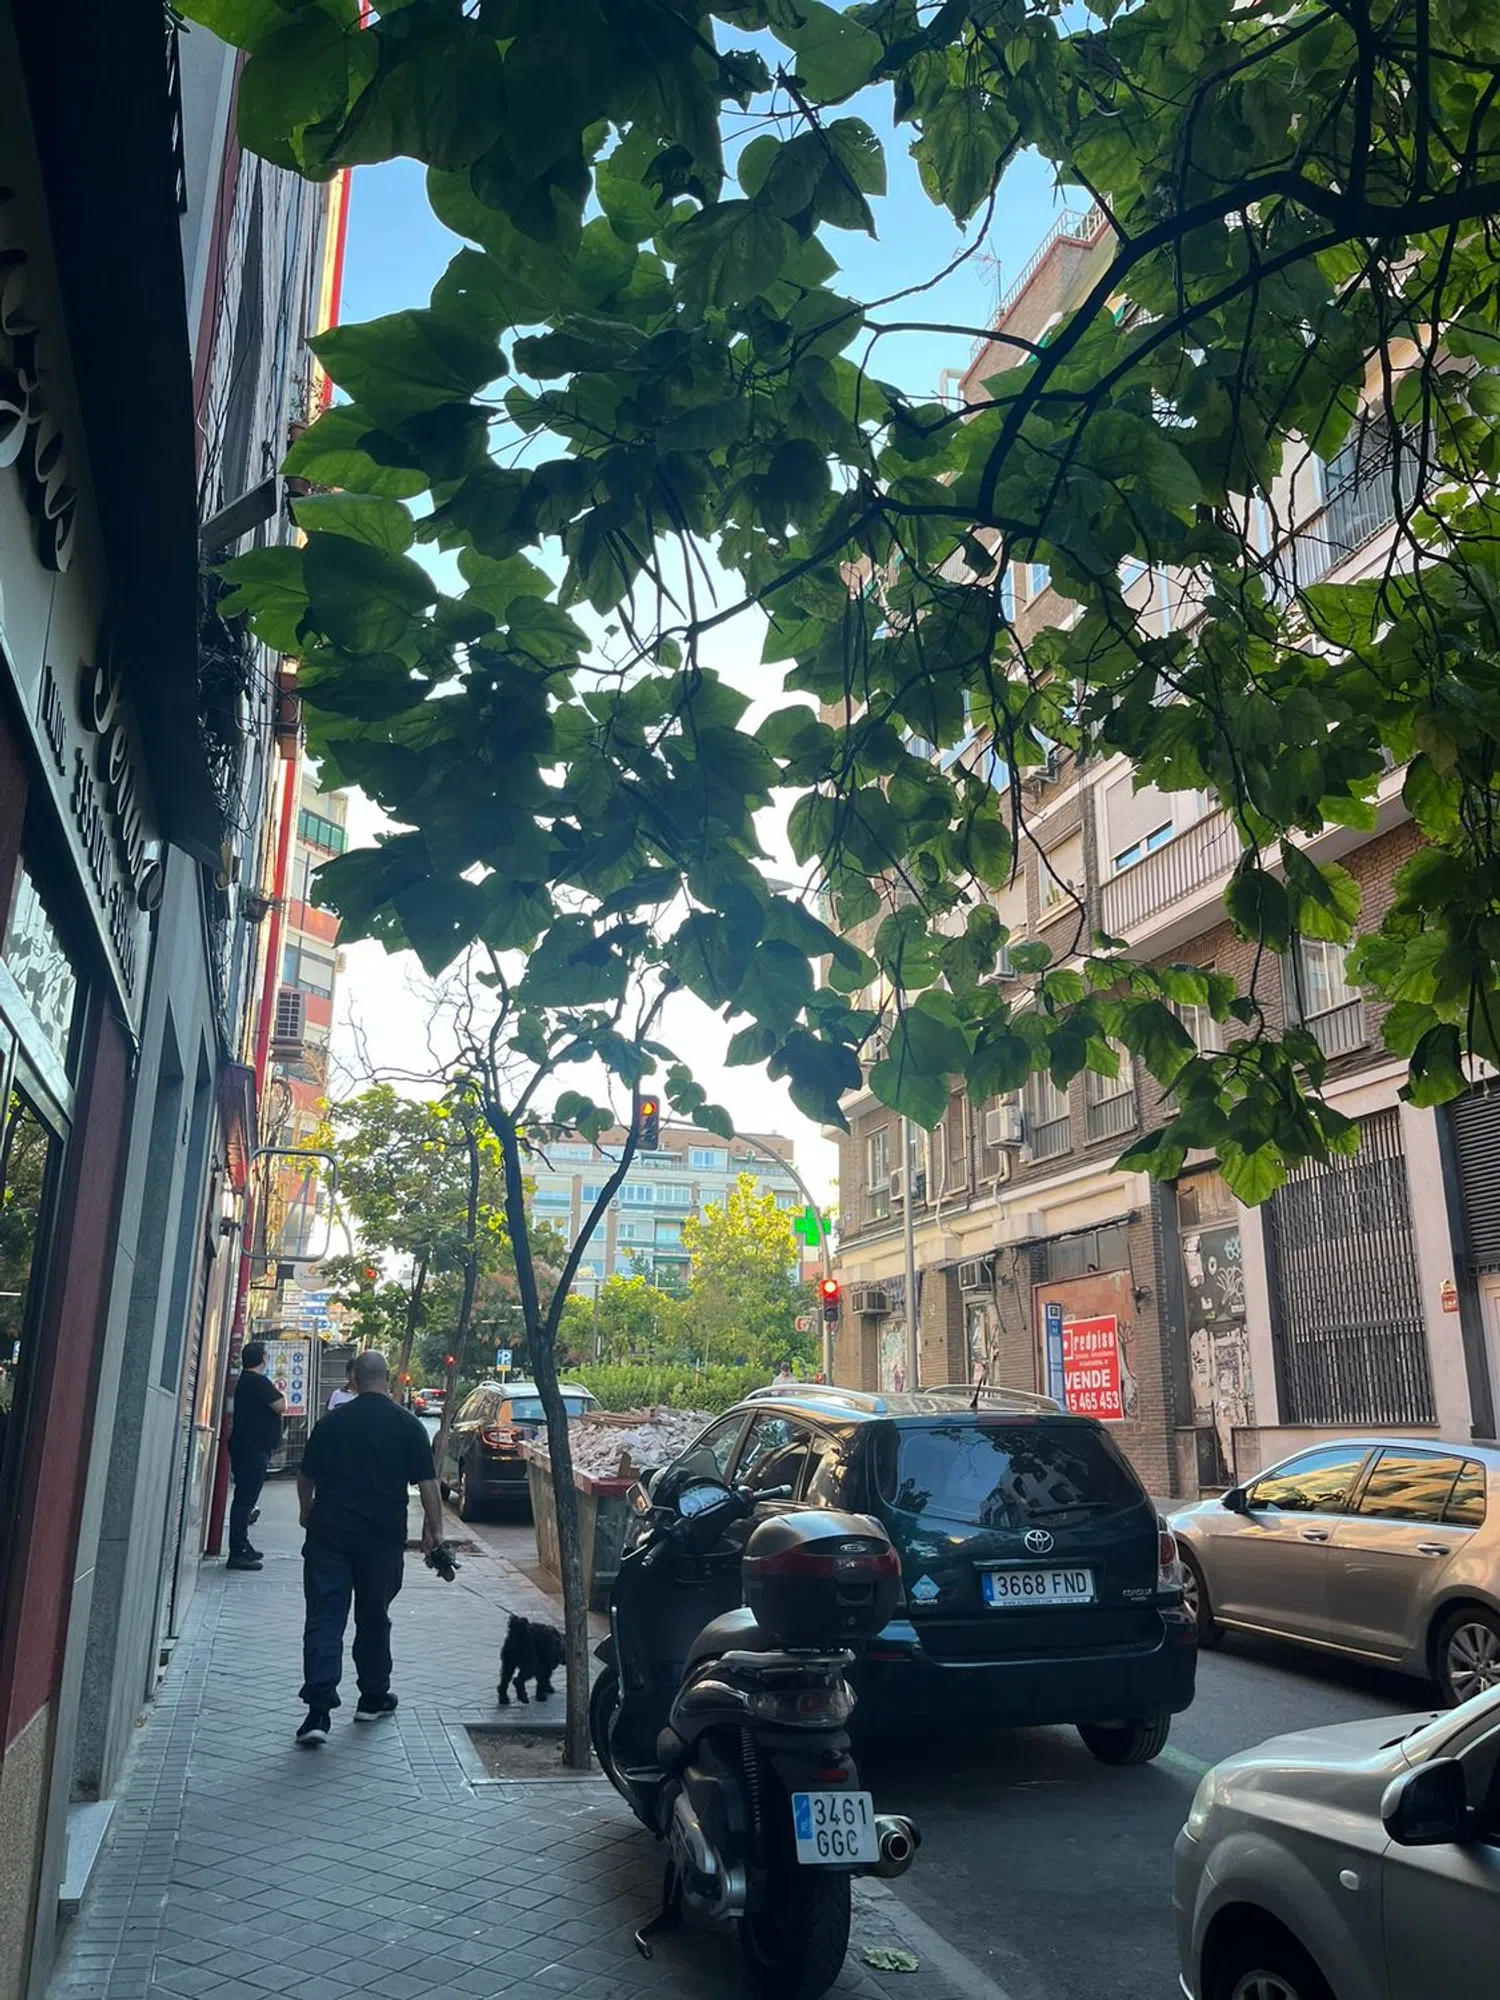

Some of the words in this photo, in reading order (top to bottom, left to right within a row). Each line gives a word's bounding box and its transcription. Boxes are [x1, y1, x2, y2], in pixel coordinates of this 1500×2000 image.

[1073, 1330, 1115, 1352] redpiso
[1065, 1369, 1112, 1391] VENDE
[1080, 1391, 1098, 1411] 465
[1099, 1390, 1120, 1410] 453
[997, 1573, 1047, 1597] 3668
[1052, 1571, 1088, 1594] FND
[814, 1798, 867, 1826] 3461
[817, 1829, 859, 1857] GGC
